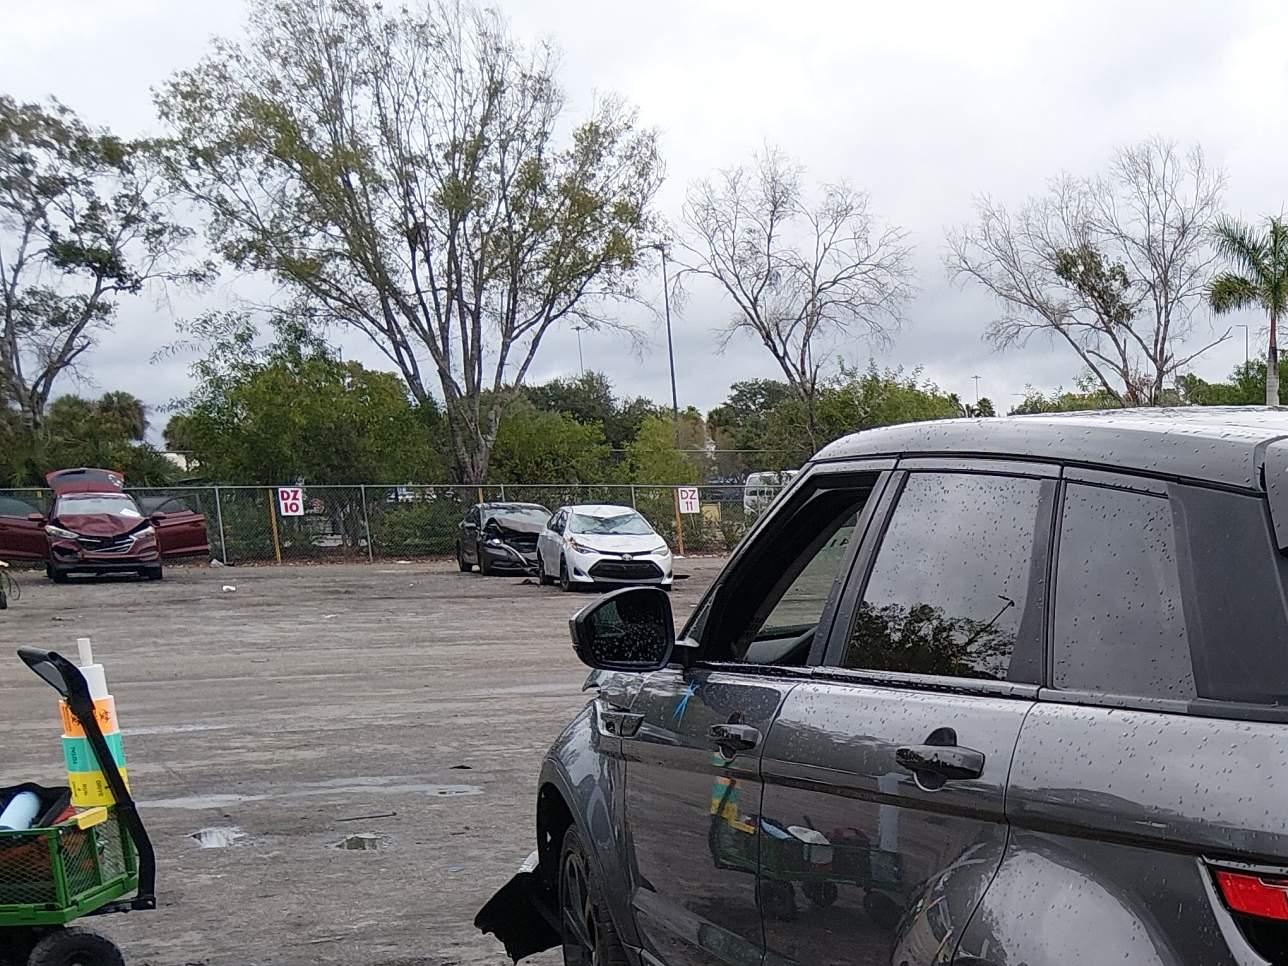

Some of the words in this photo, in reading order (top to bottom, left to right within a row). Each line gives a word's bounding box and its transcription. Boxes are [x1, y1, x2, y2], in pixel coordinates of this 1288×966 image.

[280, 490, 299, 501] DZ
[681, 490, 697, 500] DZ
[284, 502, 299, 513] 10
[685, 501, 693, 511] 11
